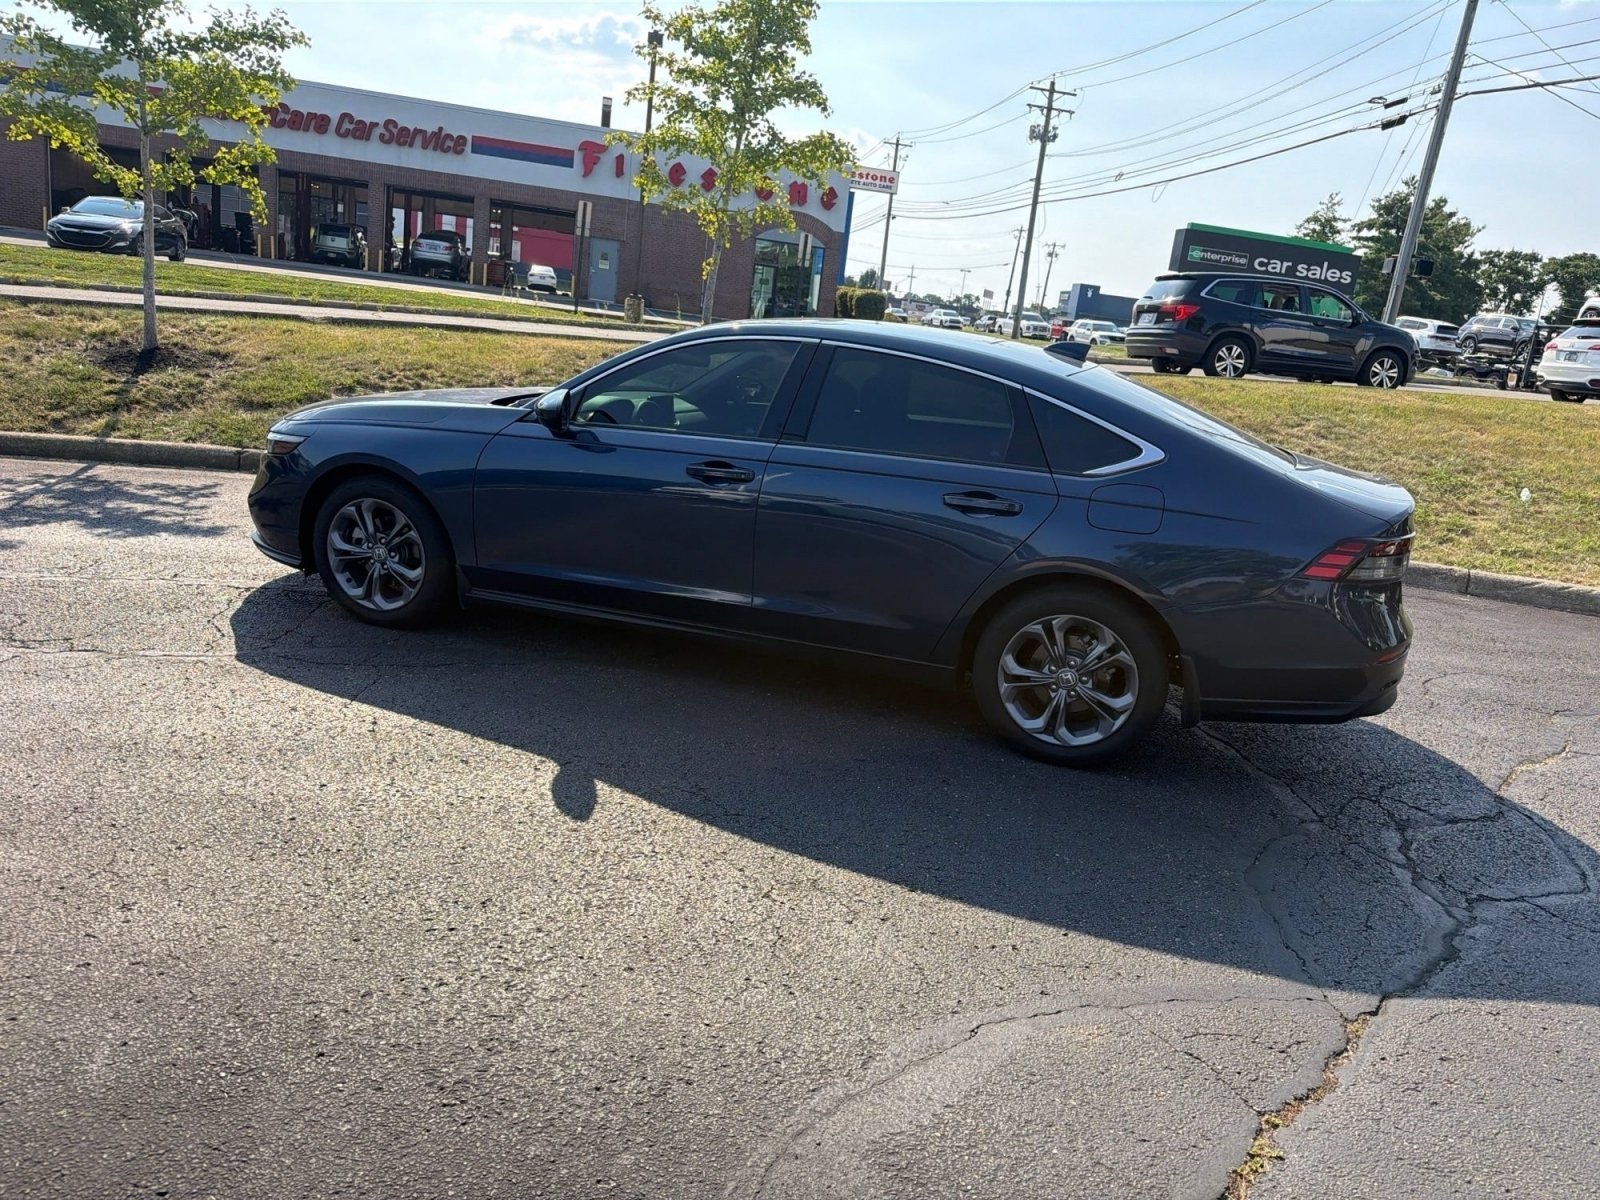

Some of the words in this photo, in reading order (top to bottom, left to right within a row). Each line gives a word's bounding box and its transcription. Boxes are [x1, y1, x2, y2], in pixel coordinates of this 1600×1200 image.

[335, 112, 380, 142] Car
[378, 118, 467, 155] Service
[577, 140, 839, 212] Fiesone
[850, 171, 896, 184] estone
[1189, 249, 1248, 265] enterprise
[1253, 257, 1293, 274] car
[1295, 261, 1353, 285] sales
